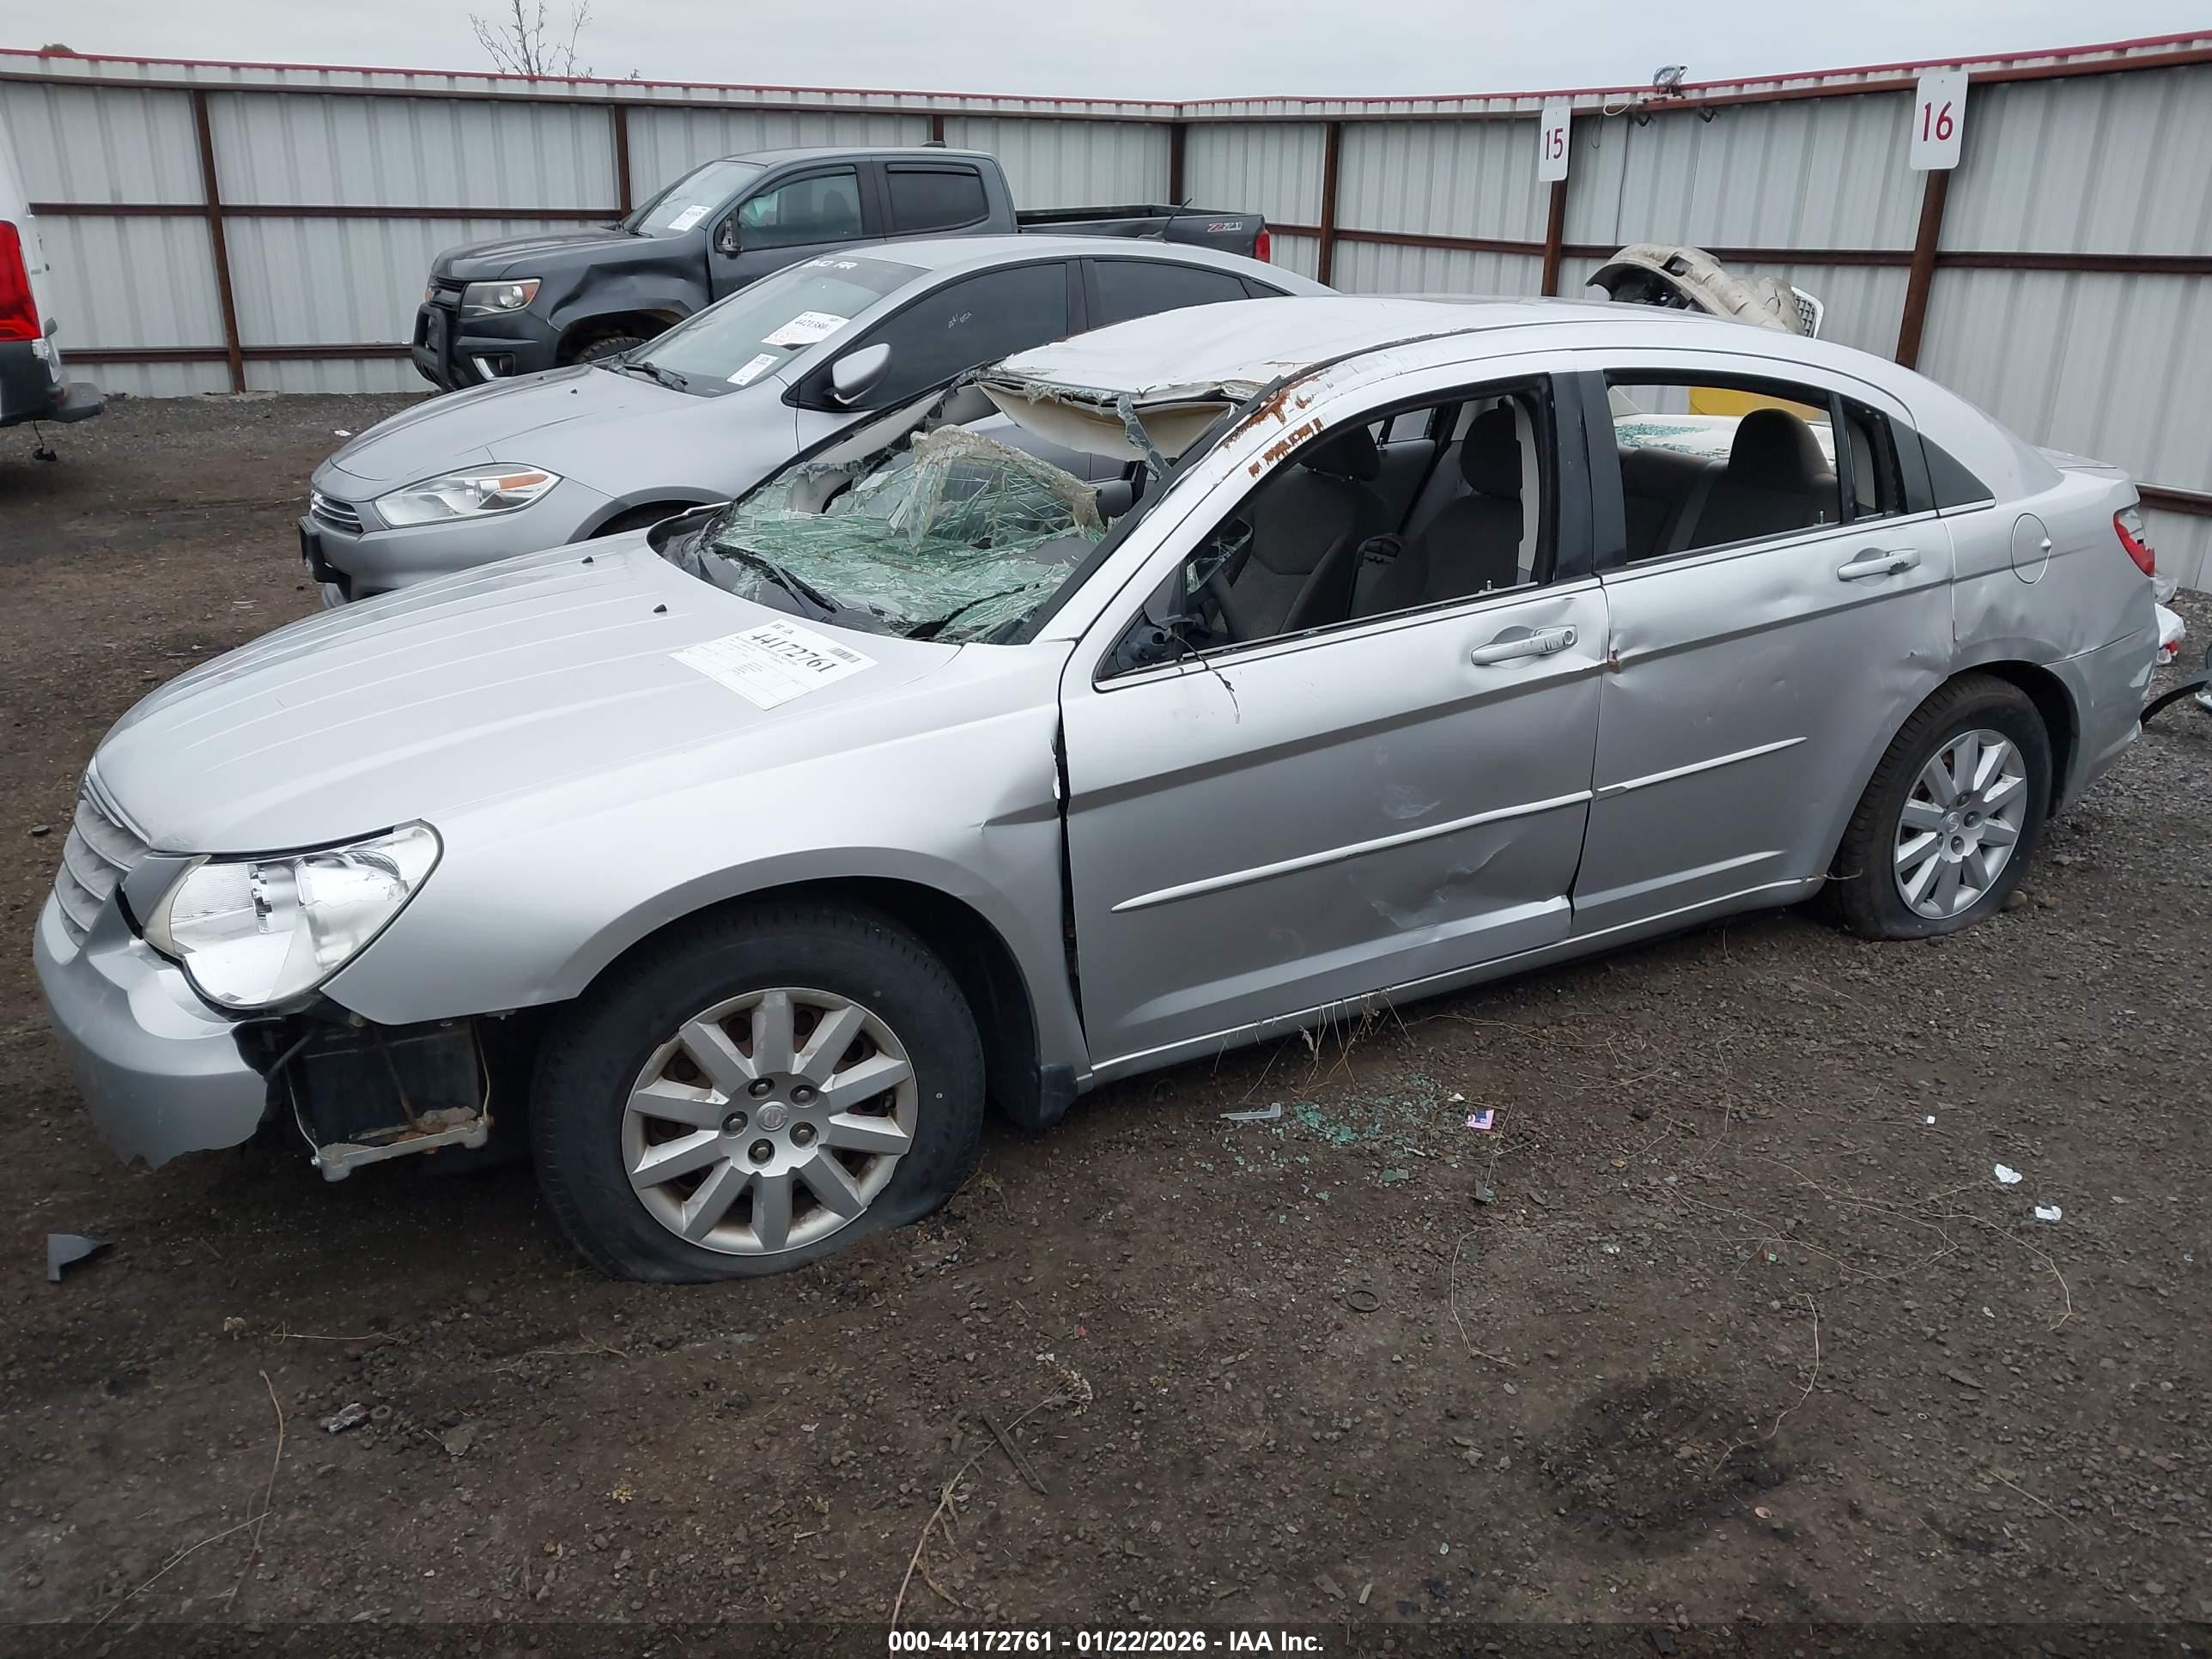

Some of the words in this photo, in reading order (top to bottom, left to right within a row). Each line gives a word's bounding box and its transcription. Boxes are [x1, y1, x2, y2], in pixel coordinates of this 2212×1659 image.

[1923, 100, 1954, 142] 16
[1546, 127, 1564, 161] 15
[750, 633, 838, 672] 44172761
